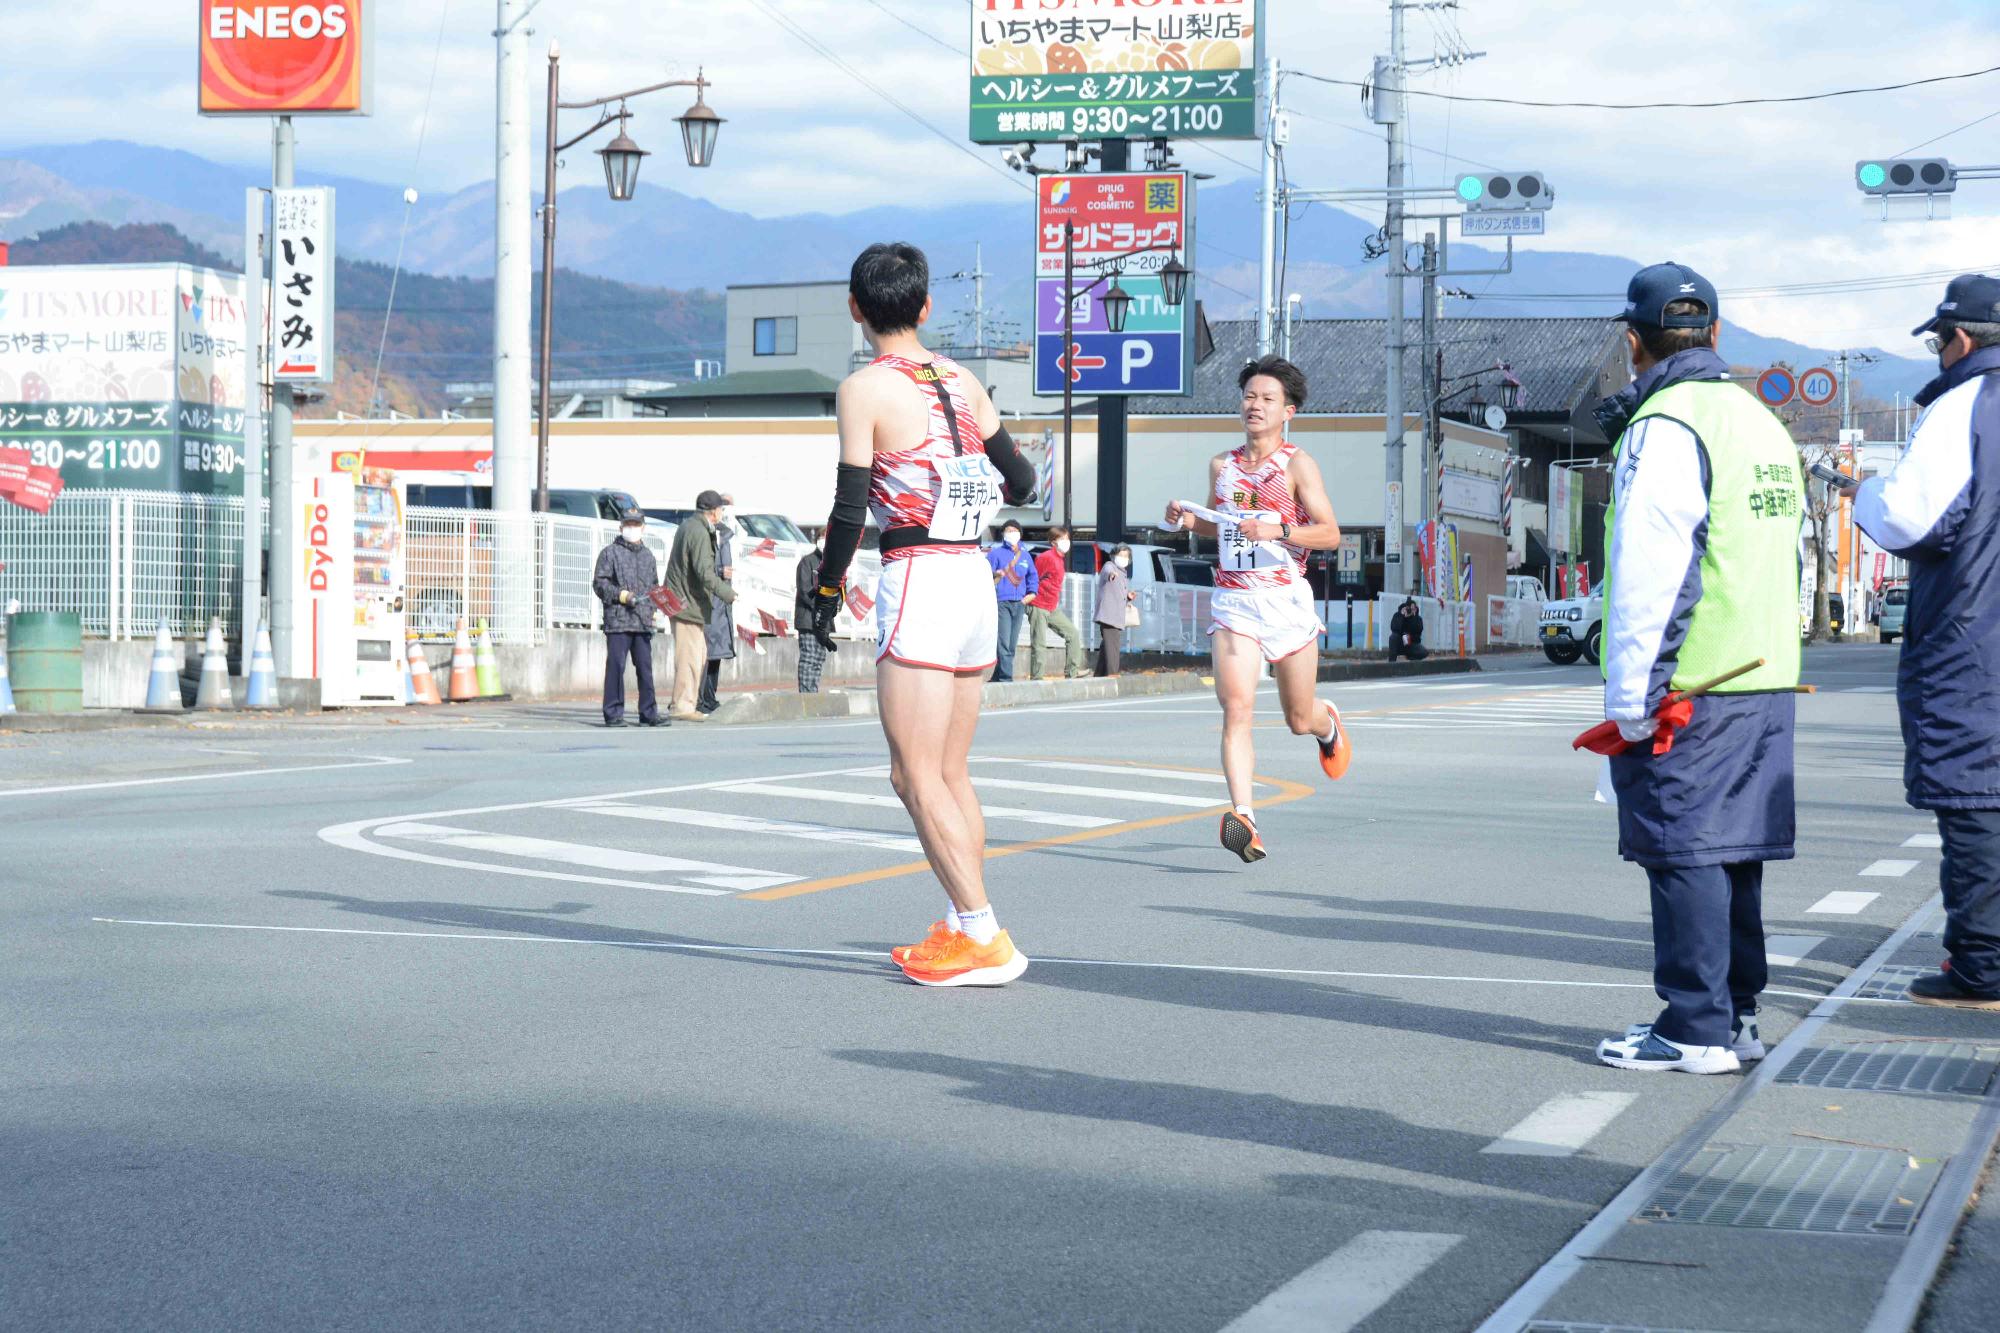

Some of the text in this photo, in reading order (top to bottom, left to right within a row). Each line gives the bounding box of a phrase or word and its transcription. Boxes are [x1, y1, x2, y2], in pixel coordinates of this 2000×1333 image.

[210, 4, 347, 39] ENEOS
[980, 12, 1242, 45] いちやまマート 山梨店
[981, 71, 1240, 102] ヘルシー&グルメフーズ
[997, 111, 1065, 132] 営業時間
[1097, 184, 1124, 193] DRUG
[1148, 182, 1175, 210] 薬
[1086, 200, 1135, 210] COSMETIC
[1043, 221, 1178, 250] サンドラッグ
[281, 236, 315, 349] いさみ
[1055, 286, 1092, 324] 酒
[105, 330, 168, 352] 山梨店
[1121, 339, 1154, 385] P
[1807, 378, 1829, 396] 40
[961, 510, 981, 537] 11
[310, 503, 334, 591] DyDo
[1234, 550, 1256, 569] 11
[1343, 549, 1357, 568] P
